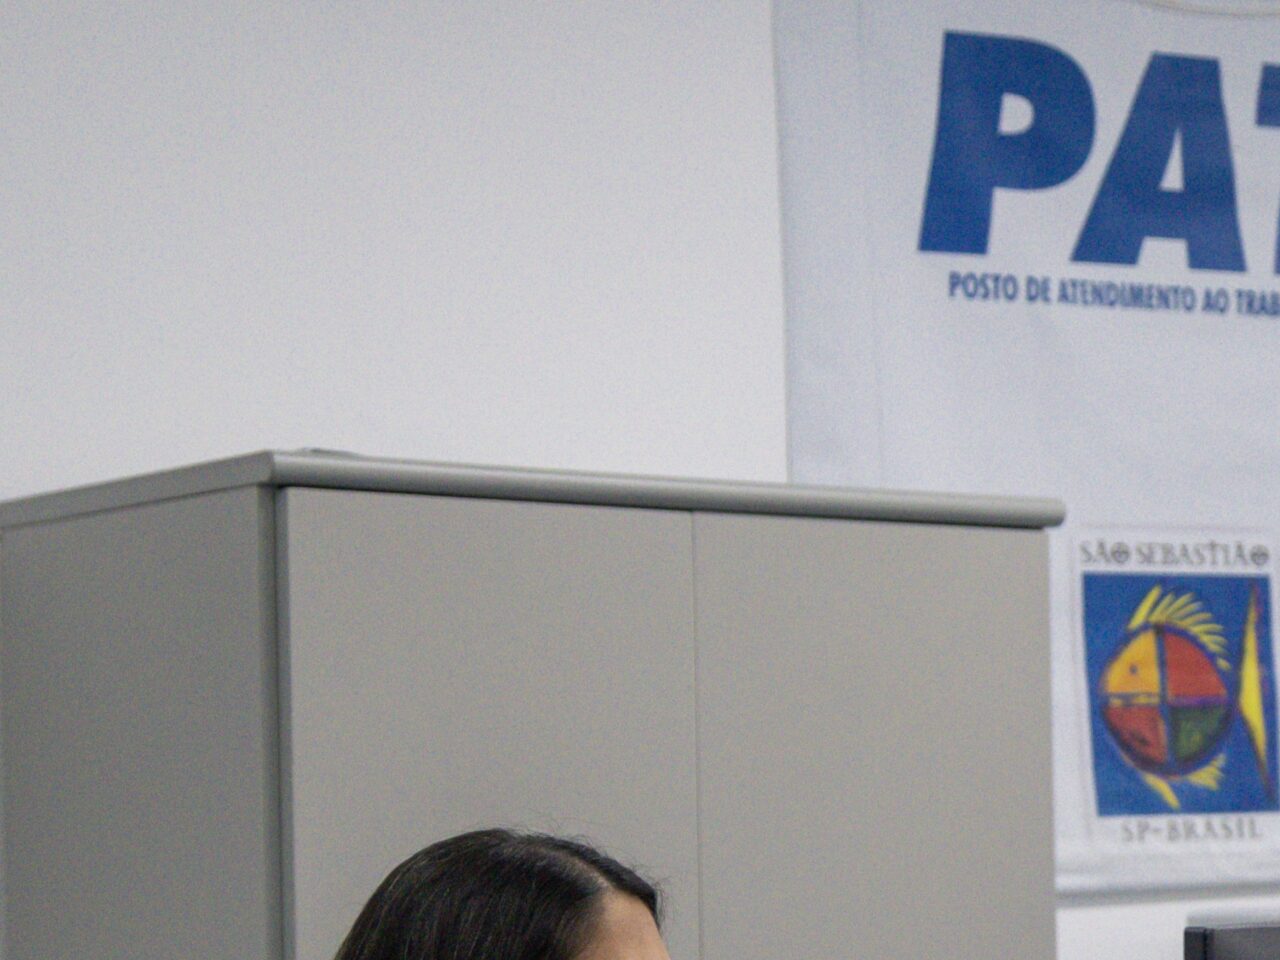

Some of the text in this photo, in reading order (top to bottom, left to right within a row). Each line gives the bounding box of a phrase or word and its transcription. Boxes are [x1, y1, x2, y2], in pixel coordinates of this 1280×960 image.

[948, 271, 1018, 301] POSTO
[1024, 275, 1052, 303] DE
[1057, 277, 1196, 313] ATENDIMENTO
[1202, 286, 1229, 315] AO
